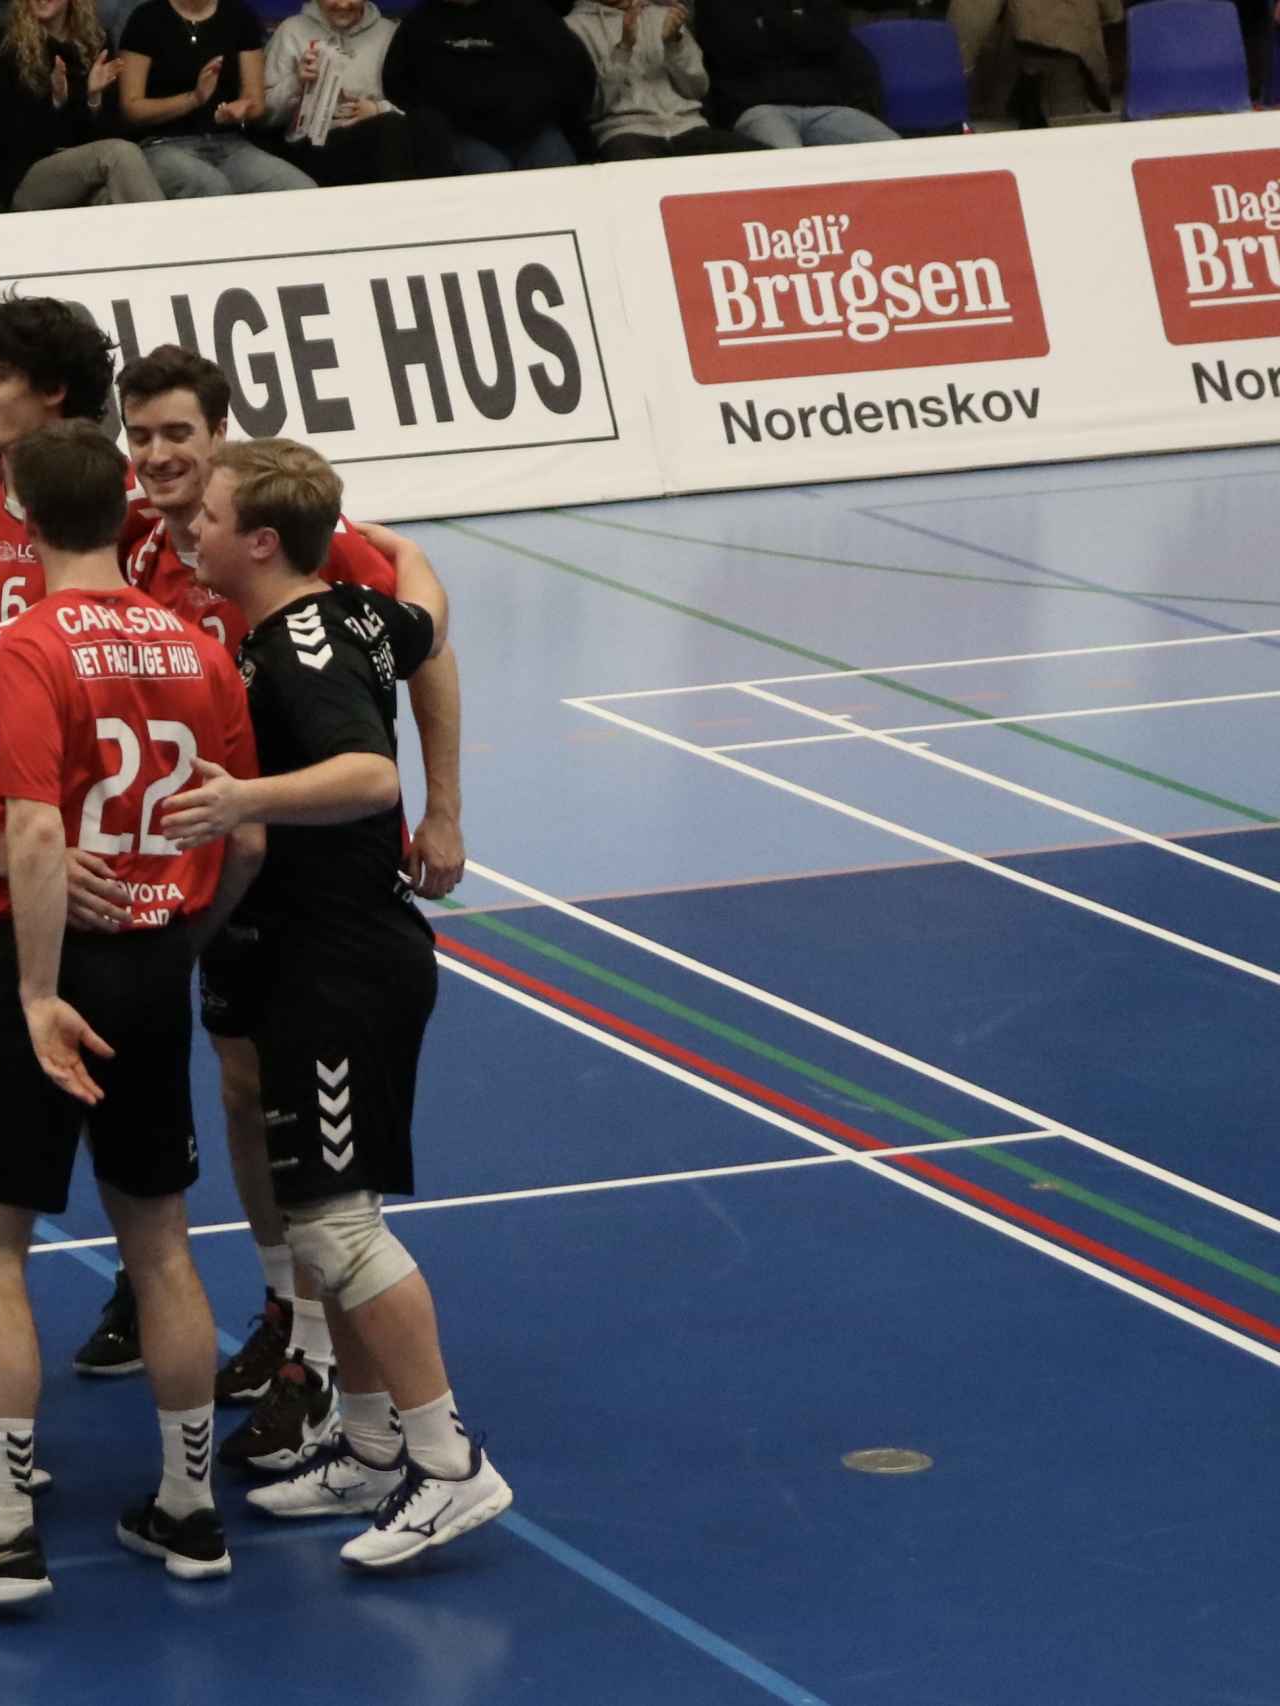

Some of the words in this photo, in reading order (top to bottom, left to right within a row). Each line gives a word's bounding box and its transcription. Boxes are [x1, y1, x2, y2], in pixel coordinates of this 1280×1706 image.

[703, 250, 1010, 342] Brugsen
[370, 263, 583, 427] HUS
[720, 383, 1040, 445] Nordenskov
[1, 576, 28, 625] 6
[56, 604, 185, 635] CARLSON
[167, 645, 199, 675] HUS
[78, 717, 197, 856] 22
